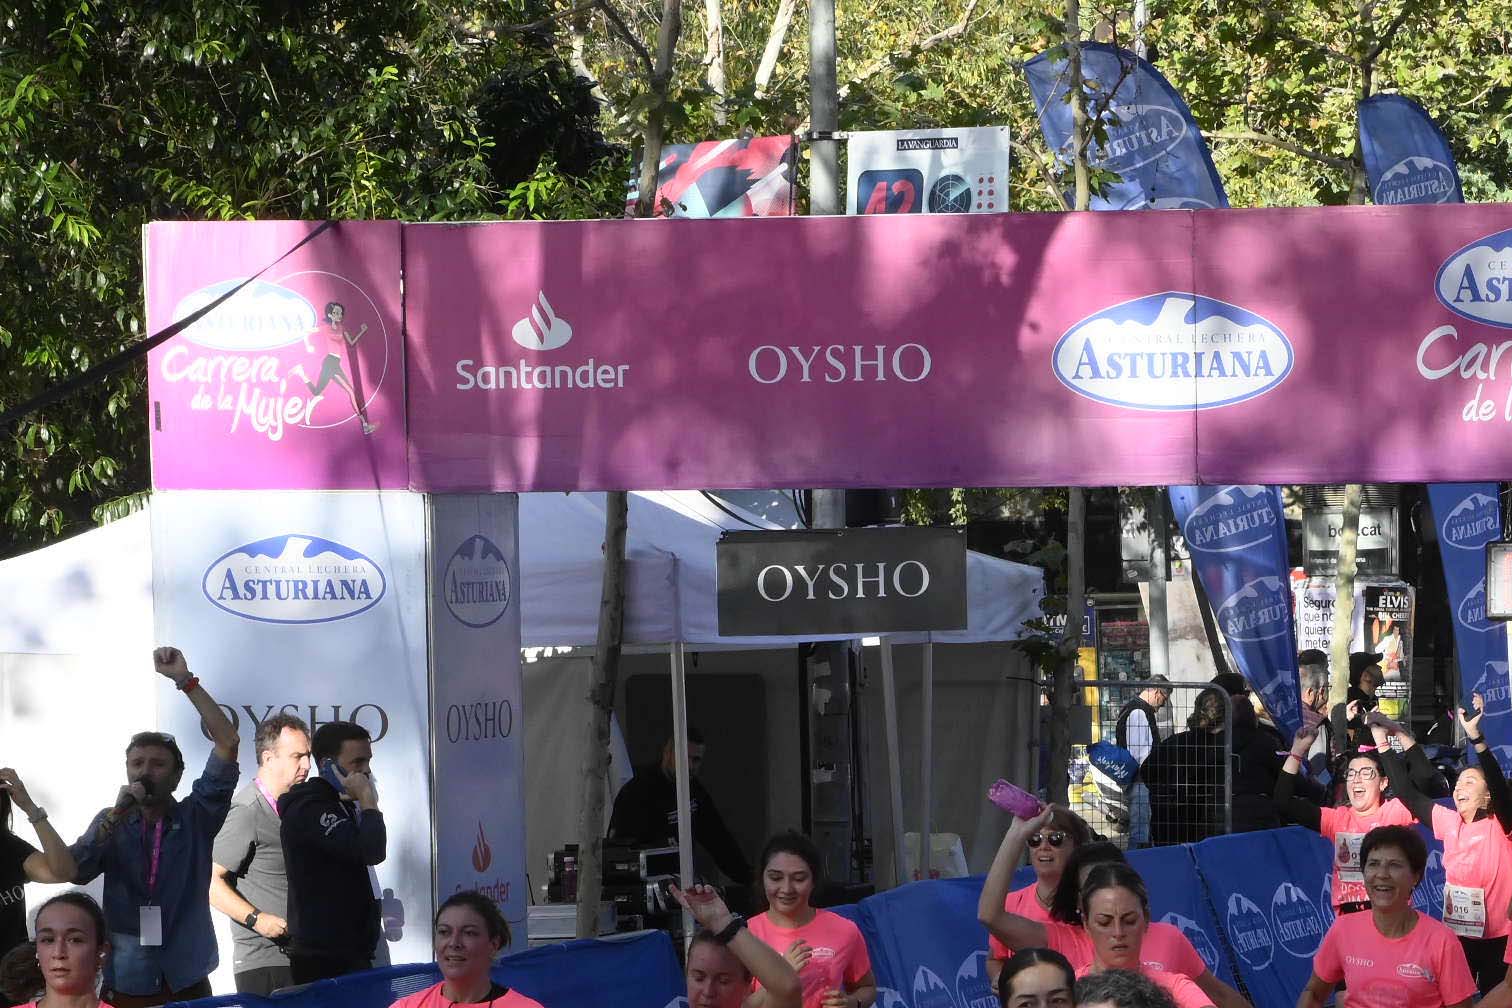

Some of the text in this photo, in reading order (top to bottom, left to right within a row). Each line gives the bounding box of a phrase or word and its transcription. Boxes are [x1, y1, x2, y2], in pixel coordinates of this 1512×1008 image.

[1108, 331, 1265, 346] CENTRAL LECHERA
[160, 347, 280, 383] Carrera
[456, 359, 630, 390] Santander
[748, 343, 932, 384] OYSHO
[1072, 340, 1275, 381] ASTURIANA
[230, 378, 325, 441] Mujer
[1462, 382, 1496, 422] de
[216, 567, 373, 601] ASTURIANA
[244, 565, 367, 576] CENTRAL LECHERA
[757, 560, 930, 602] OYSHO
[1379, 596, 1409, 609] ELVIS
[446, 699, 513, 743] OYSHO
